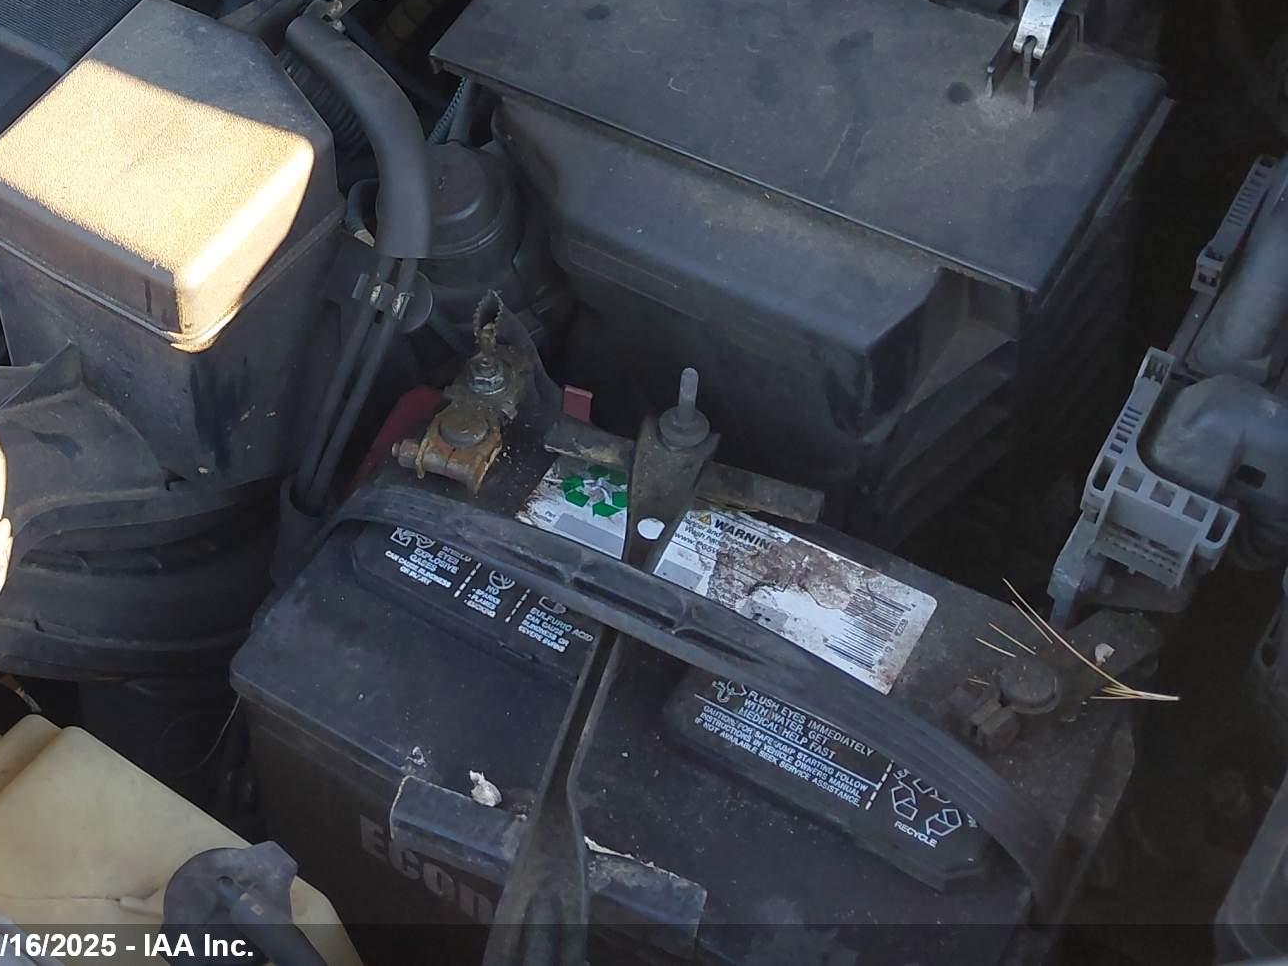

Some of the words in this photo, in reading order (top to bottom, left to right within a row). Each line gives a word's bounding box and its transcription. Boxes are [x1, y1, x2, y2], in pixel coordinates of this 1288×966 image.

[714, 518, 772, 551] WARNIN
[409, 553, 438, 572] GASES
[414, 547, 460, 574] EXPLOSIVE
[437, 550, 460, 566] EYES
[485, 584, 500, 595] NO
[525, 613, 541, 625] CAN
[541, 621, 565, 636] CAUSE
[529, 607, 573, 632] SULFURIC
[572, 628, 594, 642] ACID
[557, 637, 570, 647] OR
[737, 706, 779, 733] MEDICAL
[781, 728, 809, 745] HELP
[809, 742, 837, 760] FAST
[744, 698, 769, 718] WITH
[808, 730, 830, 746] GET
[748, 690, 781, 712] FLUSH
[781, 706, 807, 725] EYES
[807, 719, 876, 758] IMMEDIATELY
[700, 712, 752, 742] INSTRUCTIONS
[752, 738, 762, 748] IN
[763, 743, 794, 764] VEHICLE
[794, 760, 828, 780] OWNERS
[702, 722, 720, 734] NOT
[719, 731, 759, 755] AVAILABLE
[758, 750, 780, 765] SEEK
[779, 760, 812, 781] SERVICE
[796, 752, 835, 775] STARTING
[835, 770, 869, 792] FOLLOW
[894, 820, 938, 848] RECYCLE
